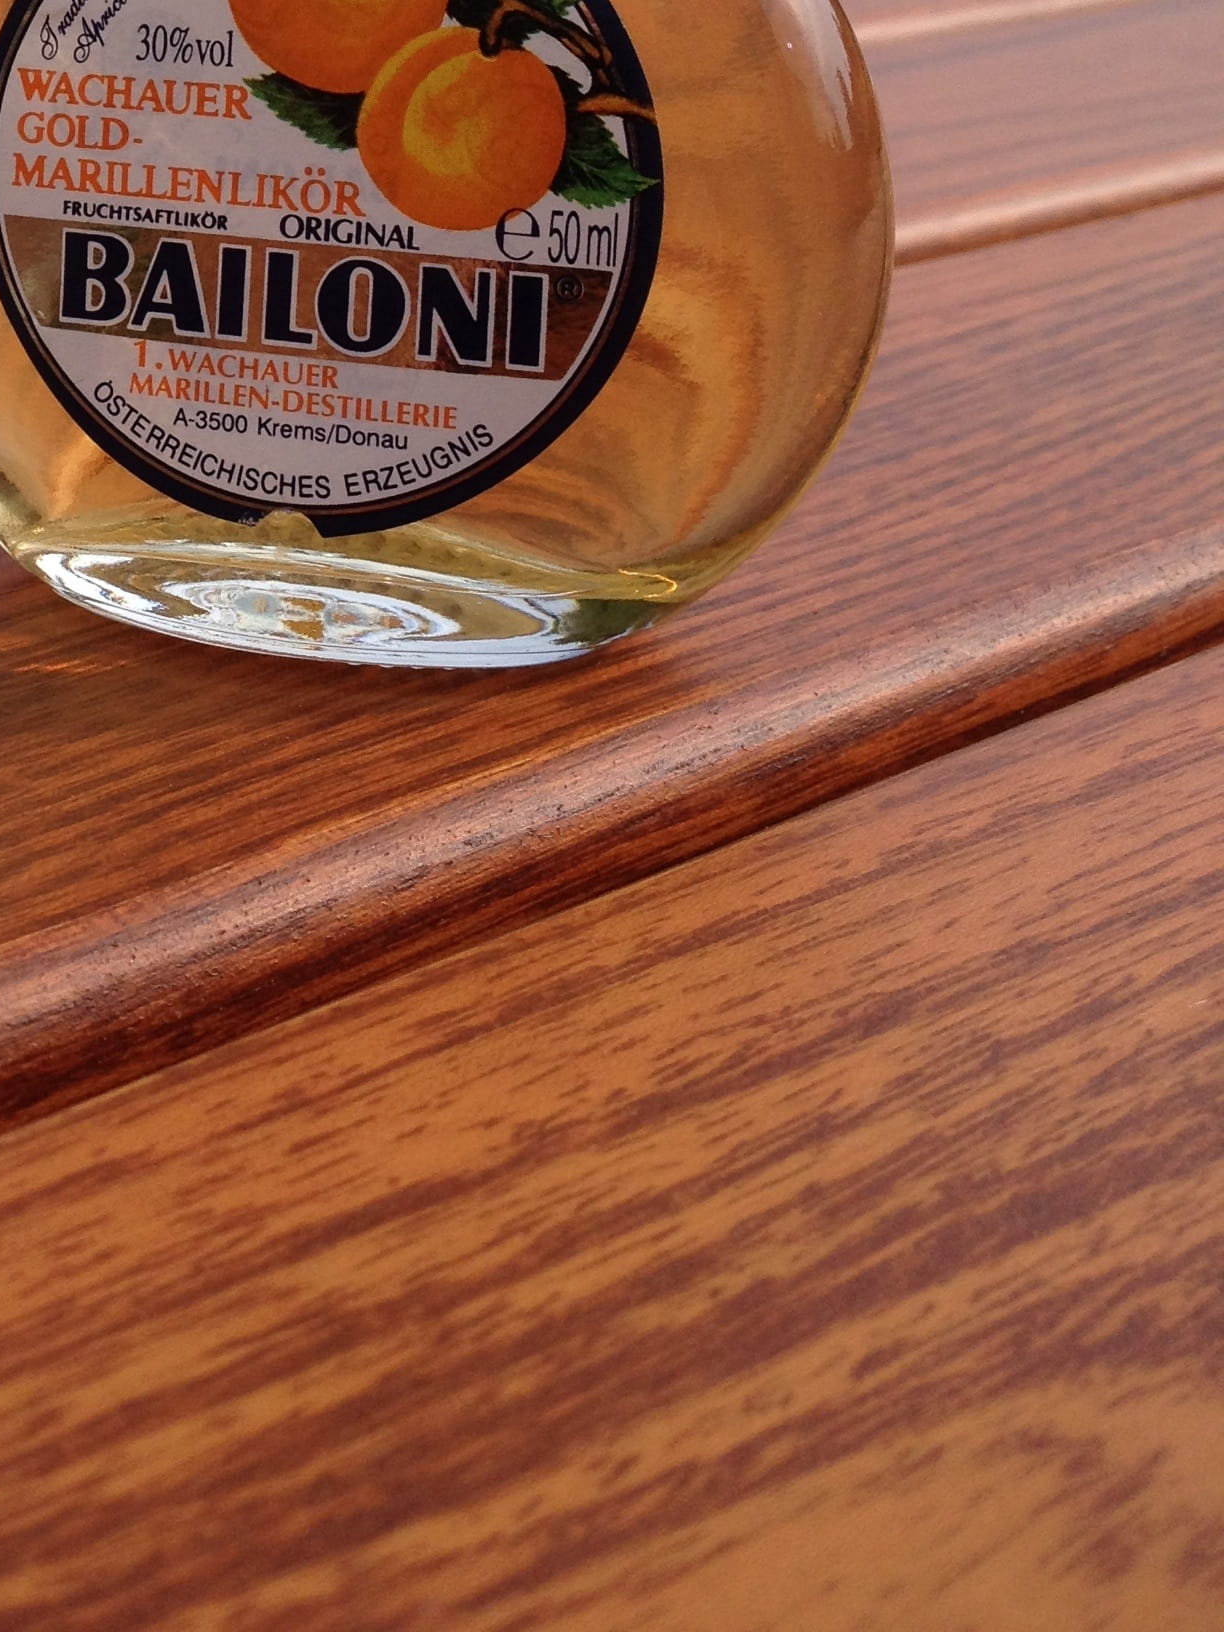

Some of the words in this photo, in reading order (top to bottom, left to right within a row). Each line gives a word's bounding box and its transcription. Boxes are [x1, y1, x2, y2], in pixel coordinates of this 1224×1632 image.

[17, 67, 253, 120] WACHAUER
[16, 111, 144, 152] GOLD-
[10, 152, 364, 216] MARILLENLIKÖR
[62, 199, 229, 232] FRUCHTSAFTLIKÖR
[279, 214, 421, 252] ORIGINAL
[59, 227, 550, 374] BAILONI
[129, 373, 458, 431] MARILLEN-DESTILLERIE
[172, 407, 249, 435] A-3500
[256, 416, 410, 452] Krems/Donau
[344, 422, 495, 498] ERZEUGNIS
